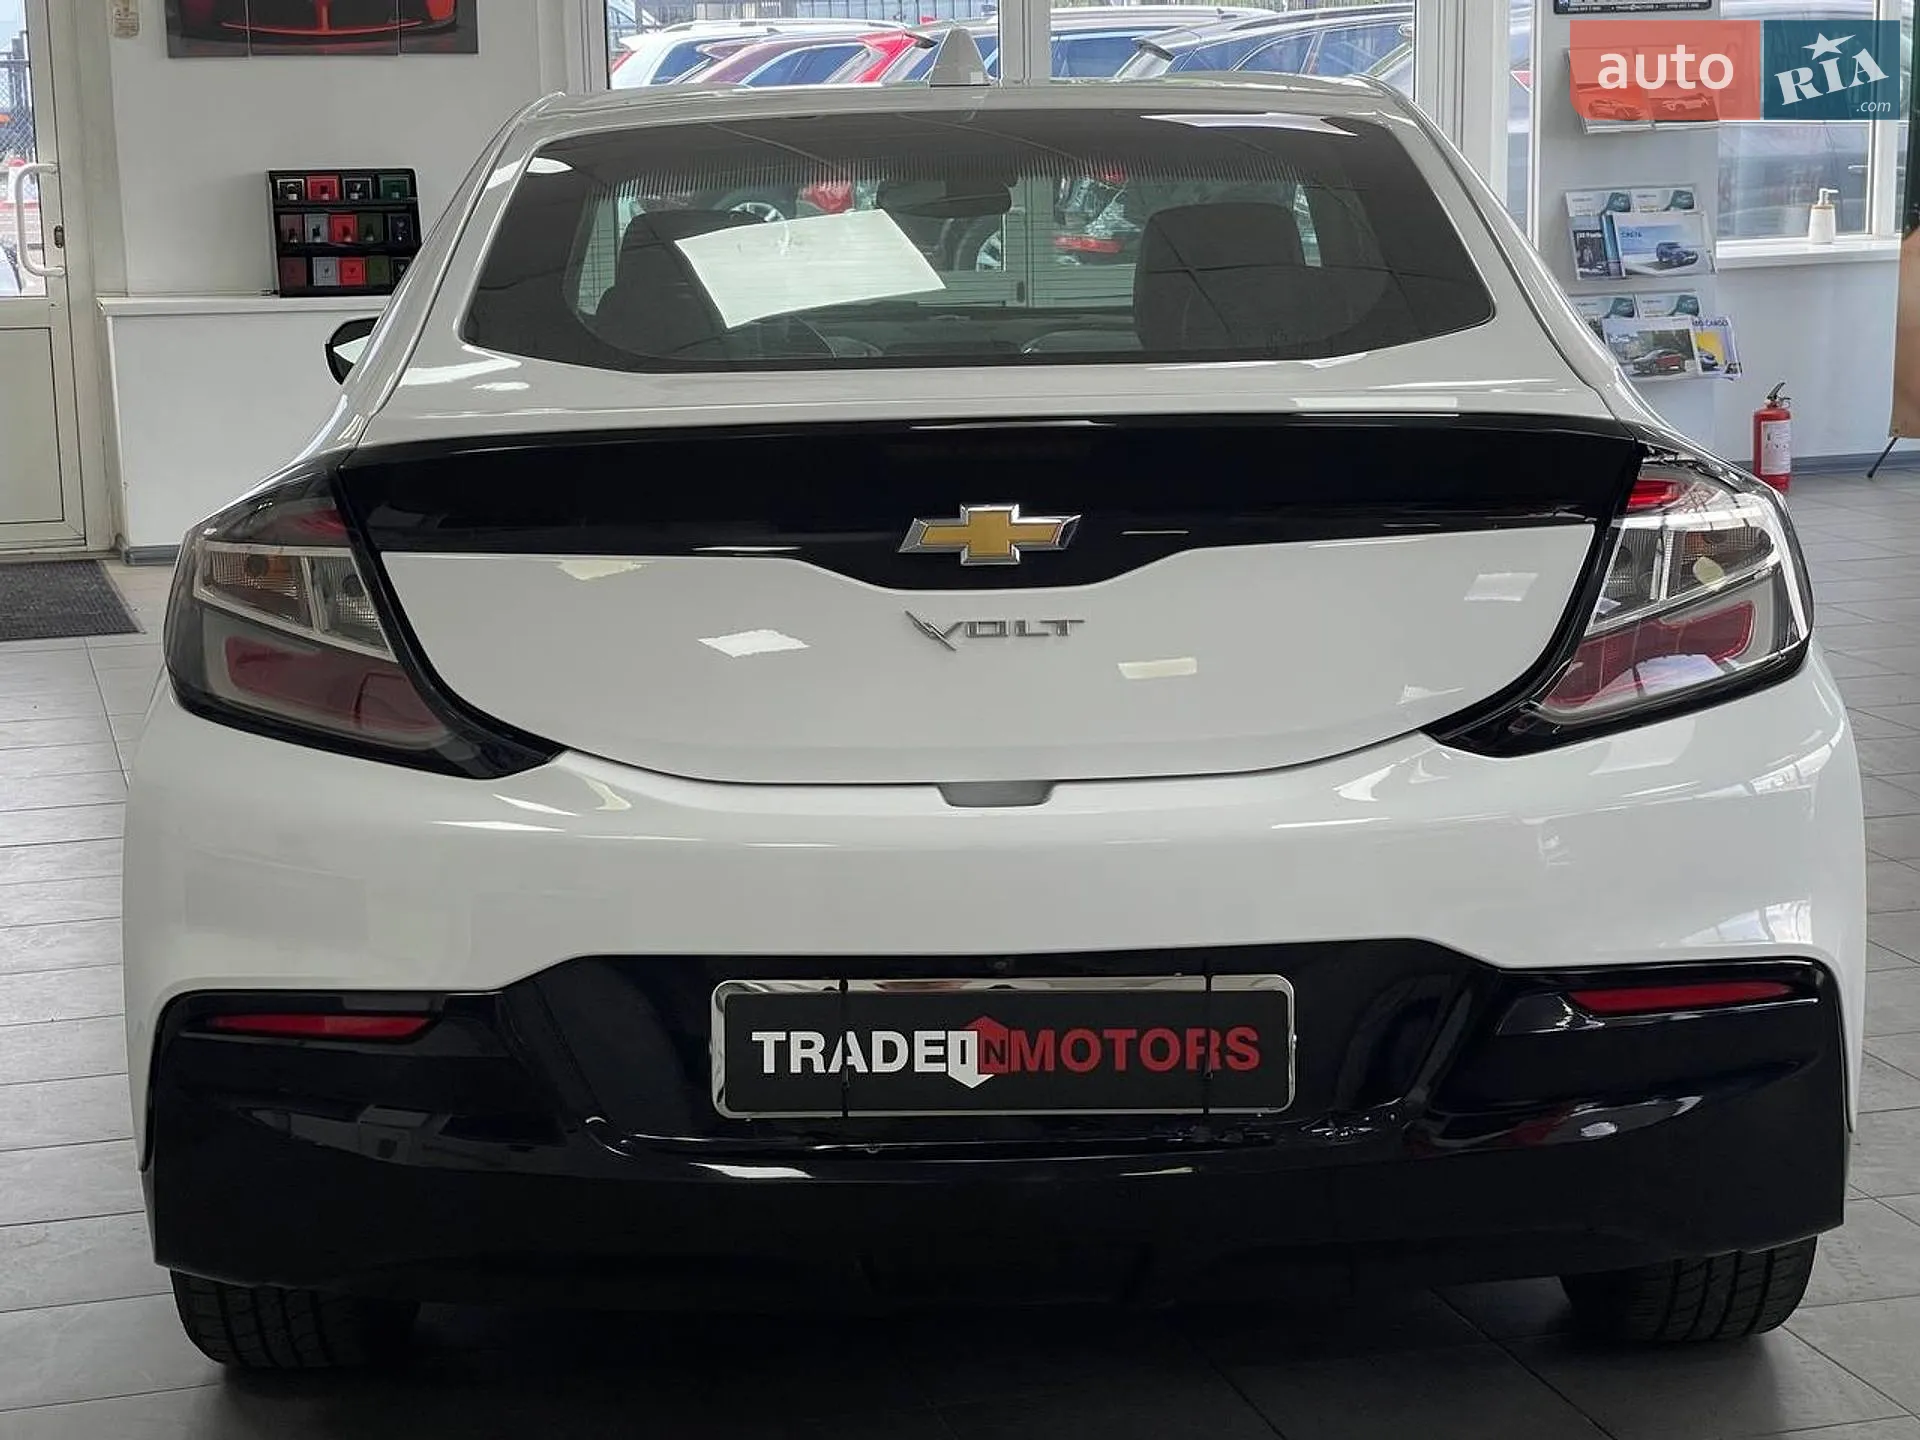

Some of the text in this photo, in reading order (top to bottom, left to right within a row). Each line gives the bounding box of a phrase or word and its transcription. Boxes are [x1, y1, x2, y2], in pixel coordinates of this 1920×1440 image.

[905, 610, 1085, 652] VOLT
[751, 1030, 947, 1074] TRADE
[1010, 1028, 1261, 1073] MOTORS
